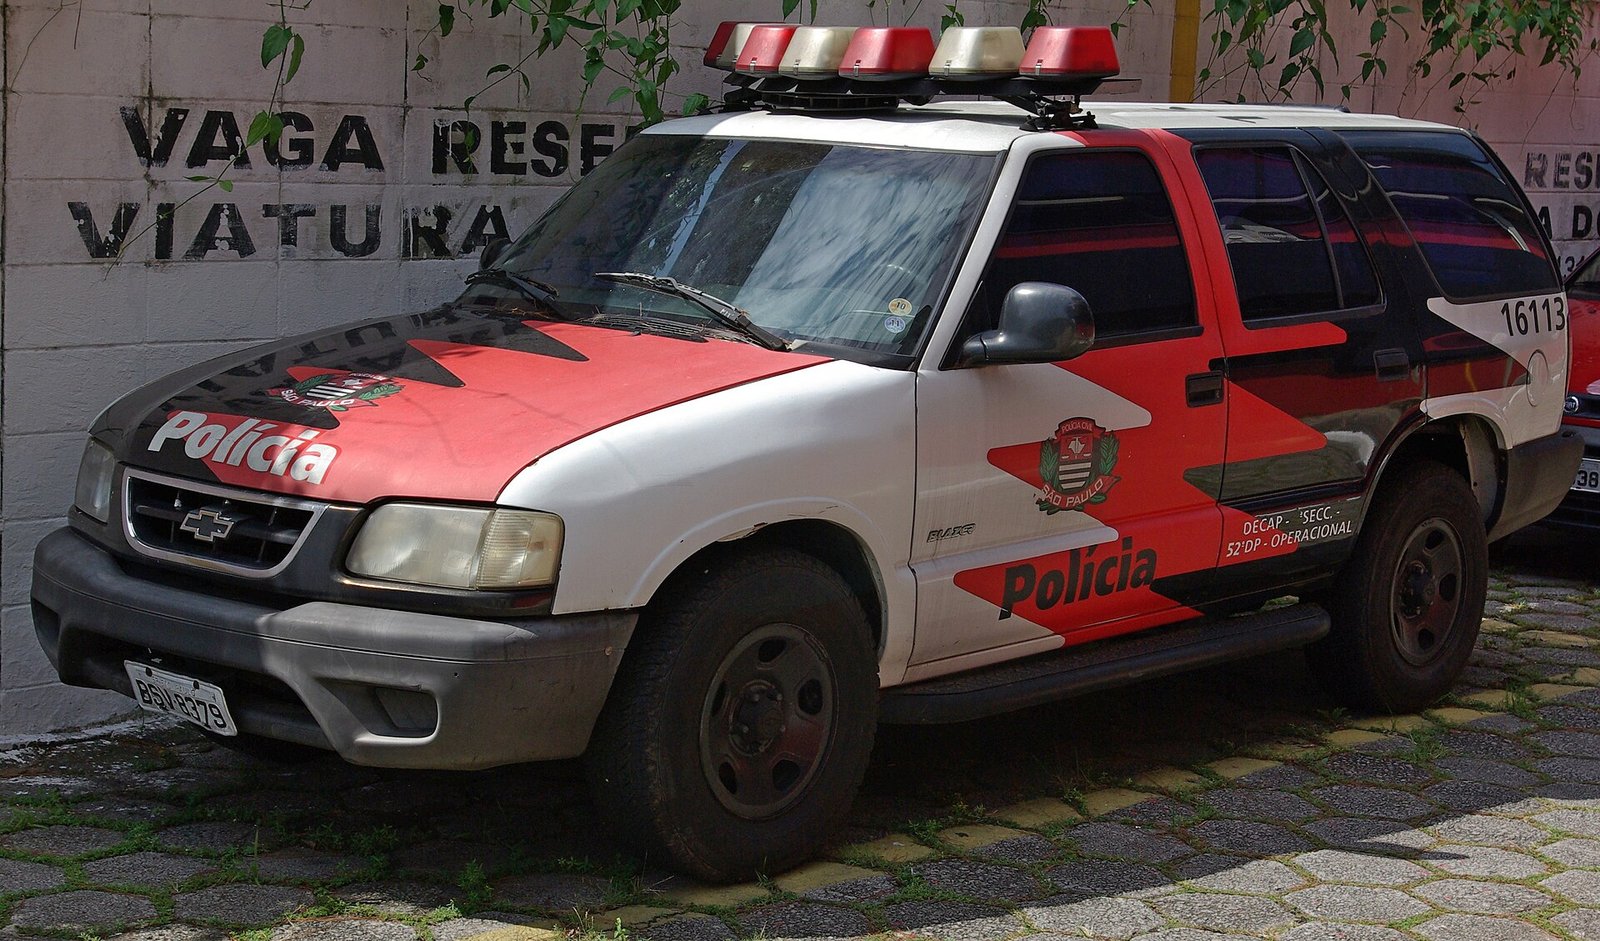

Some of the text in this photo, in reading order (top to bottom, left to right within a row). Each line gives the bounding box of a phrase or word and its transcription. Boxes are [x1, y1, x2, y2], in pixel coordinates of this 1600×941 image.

[119, 106, 638, 178] VAGA RESE
[1524, 151, 1600, 190] RES
[68, 201, 513, 259] VIATURA
[1501, 297, 1565, 337] 16113
[298, 398, 355, 407] PAULO
[148, 410, 337, 485] Polícia
[1042, 478, 1104, 507] SÃO PAULO
[1574, 469, 1599, 488] 38
[1243, 515, 1283, 536] DECAP
[1271, 520, 1352, 548] OPERACIONAL
[998, 536, 1158, 620] Polícia
